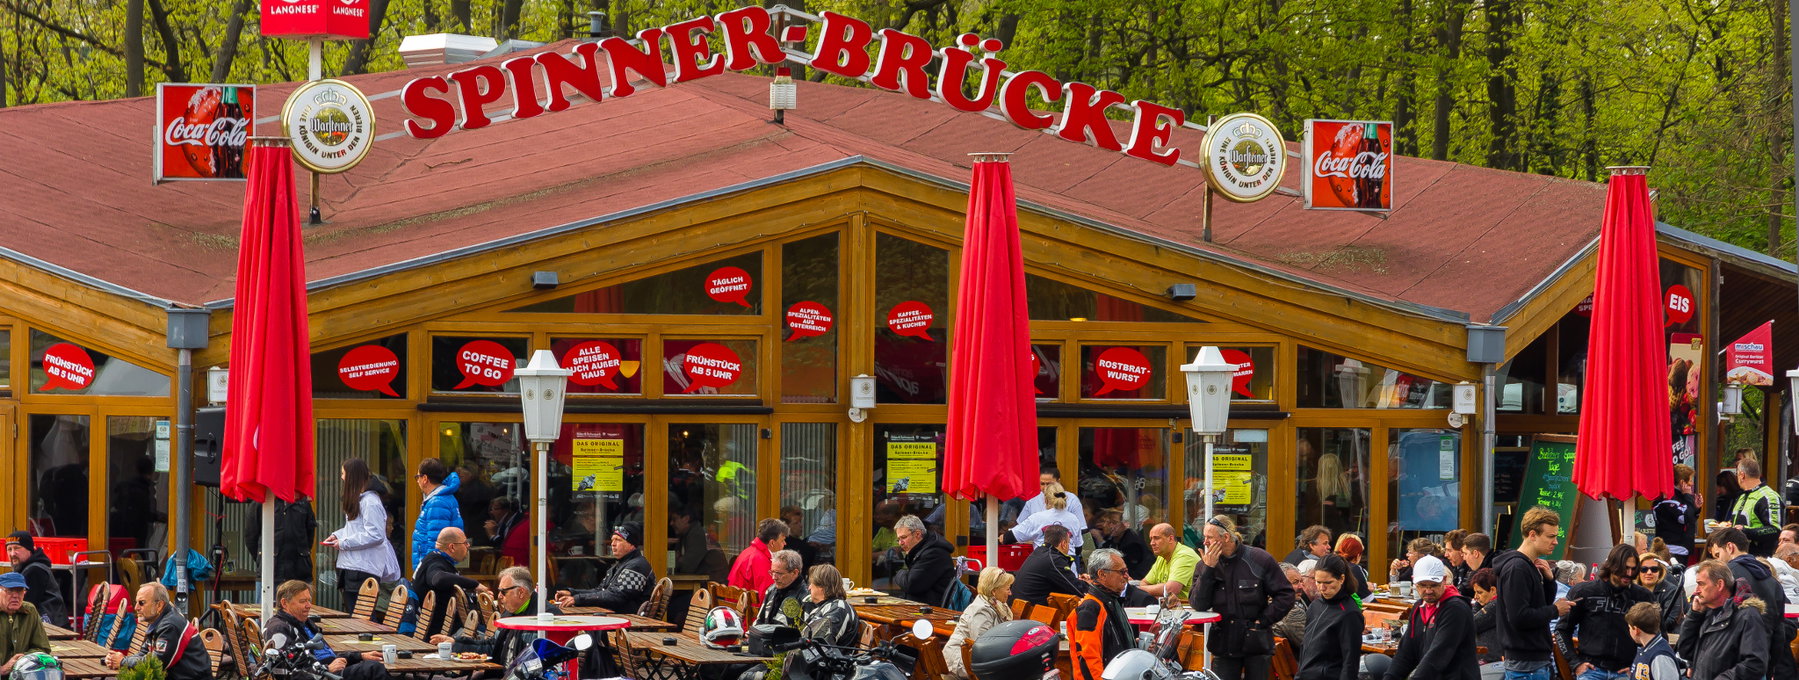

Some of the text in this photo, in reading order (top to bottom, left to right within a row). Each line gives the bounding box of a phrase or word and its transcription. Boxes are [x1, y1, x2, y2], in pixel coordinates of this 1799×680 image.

[271, 5, 317, 14] LANGNESE
[333, 6, 363, 17] LANGNESE
[401, 5, 1185, 167] SPINNER-BRÜCKE
[310, 113, 353, 138] Warsteiner
[350, 105, 362, 133] BIEREN
[165, 116, 250, 146] Coca-Cola
[299, 125, 319, 155] KÖNIGIN
[347, 136, 360, 151] DEN
[1220, 137, 1231, 153] EINE
[321, 149, 347, 159] UNTER
[1229, 145, 1268, 168] Warsteiner
[1219, 156, 1237, 184] KÖNIGIN
[1314, 150, 1389, 179] Coca-Cola
[1262, 167, 1274, 182] DEN
[1238, 180, 1262, 188] UNTER
[712, 276, 744, 286] TÄGLICH
[710, 283, 748, 294] GEÖFFNET
[1669, 293, 1690, 313] EIS
[787, 311, 831, 322] SPEZIALITÄTEN
[889, 314, 933, 325] SPEZIALITÄTEN
[790, 321, 826, 332] ÖSTERREICH
[902, 321, 926, 329] KUCHEN
[579, 346, 601, 356] ALLE
[45, 353, 93, 377] FRÜHSTÜCK
[462, 350, 509, 369] COFFEE
[572, 353, 609, 365] SPEISEN
[686, 354, 740, 371] FRÜHSTÜCK
[340, 360, 397, 373] SELBSTBEDIENUNG
[348, 367, 390, 378] SELF SERVICE
[464, 363, 502, 380] TO GO
[691, 366, 704, 375] AB
[713, 369, 732, 380] UHR
[48, 366, 85, 385] AB 5 UHR
[581, 369, 606, 380] HAUS
[1107, 370, 1140, 383] WURST
[1672, 440, 1684, 453] FEE
